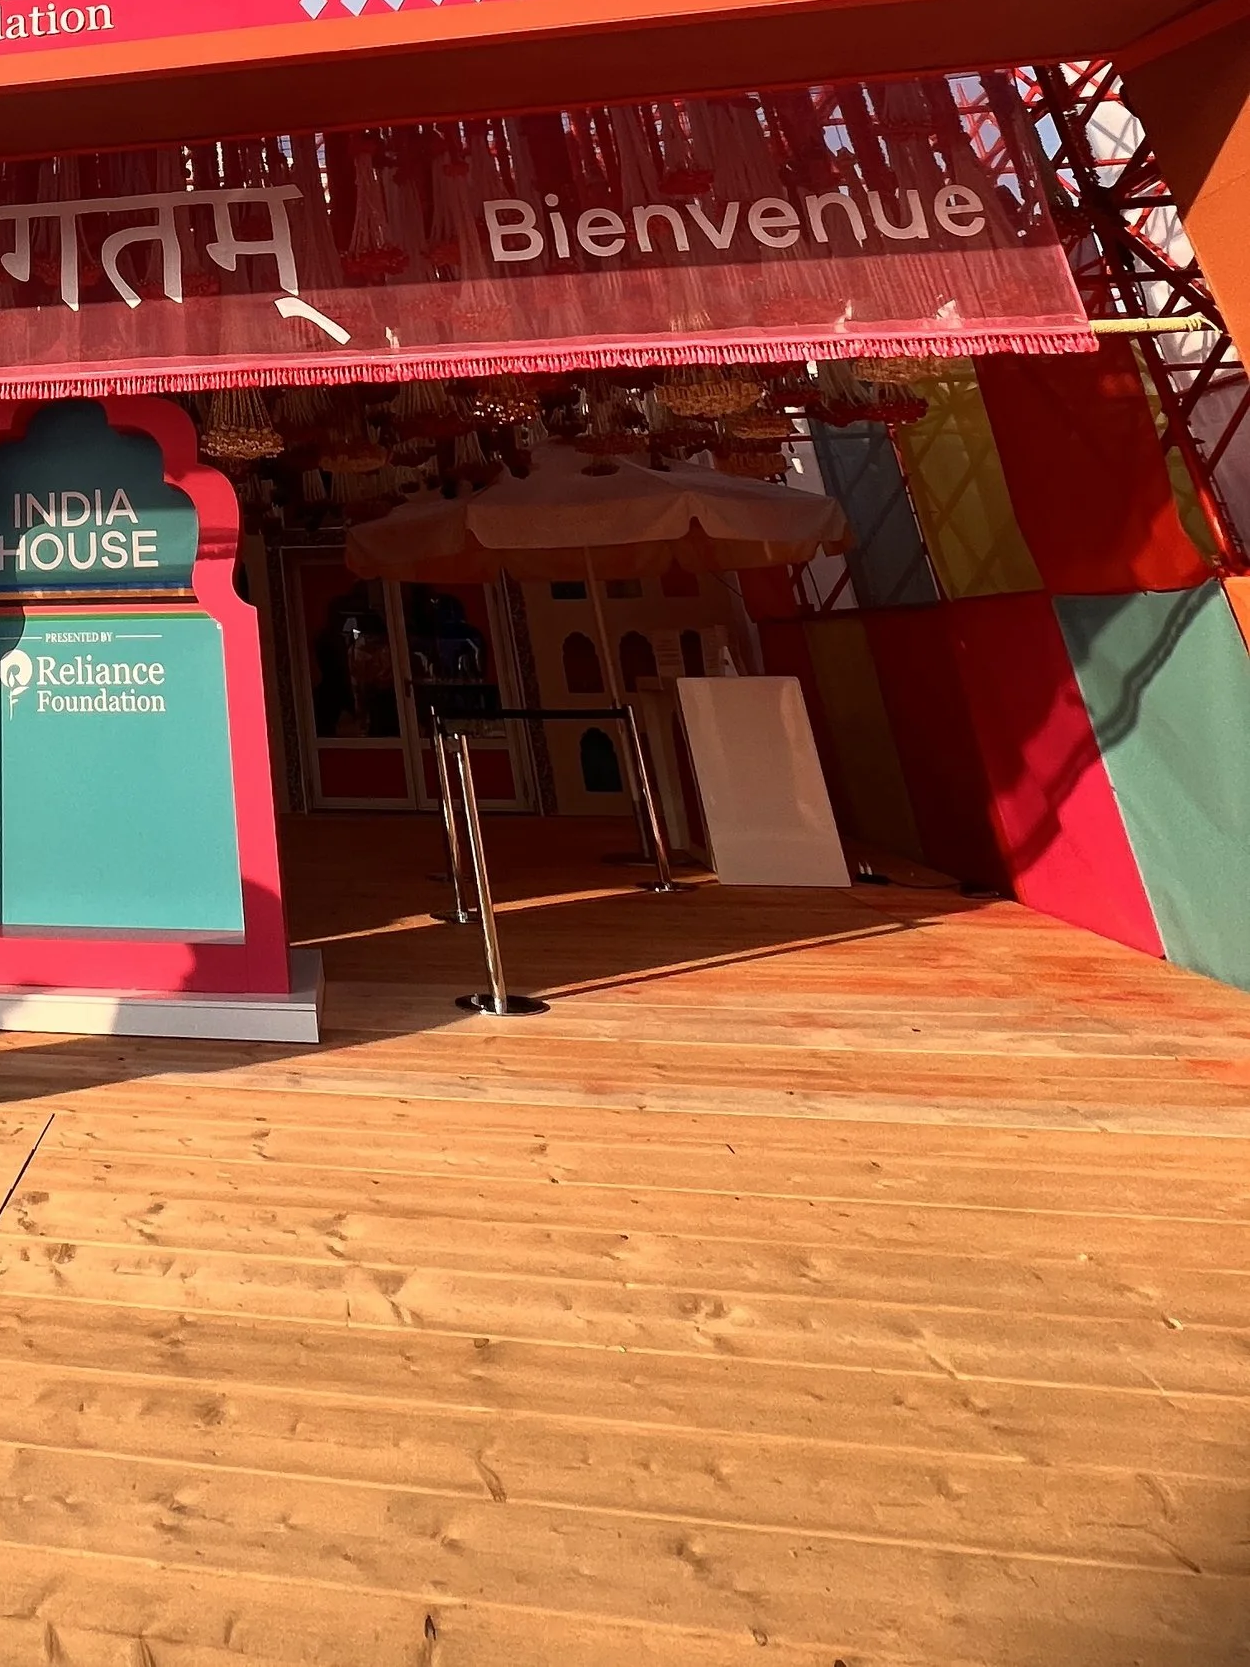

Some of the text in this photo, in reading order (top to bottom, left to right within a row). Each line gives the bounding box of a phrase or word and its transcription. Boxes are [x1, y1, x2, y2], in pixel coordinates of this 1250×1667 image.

[482, 184, 986, 263] Bienvenue
[14, 488, 139, 528] INDIA
[45, 631, 113, 643] PRESENTED BY
[36, 654, 165, 685] Reliance
[36, 688, 166, 712] Foundation
